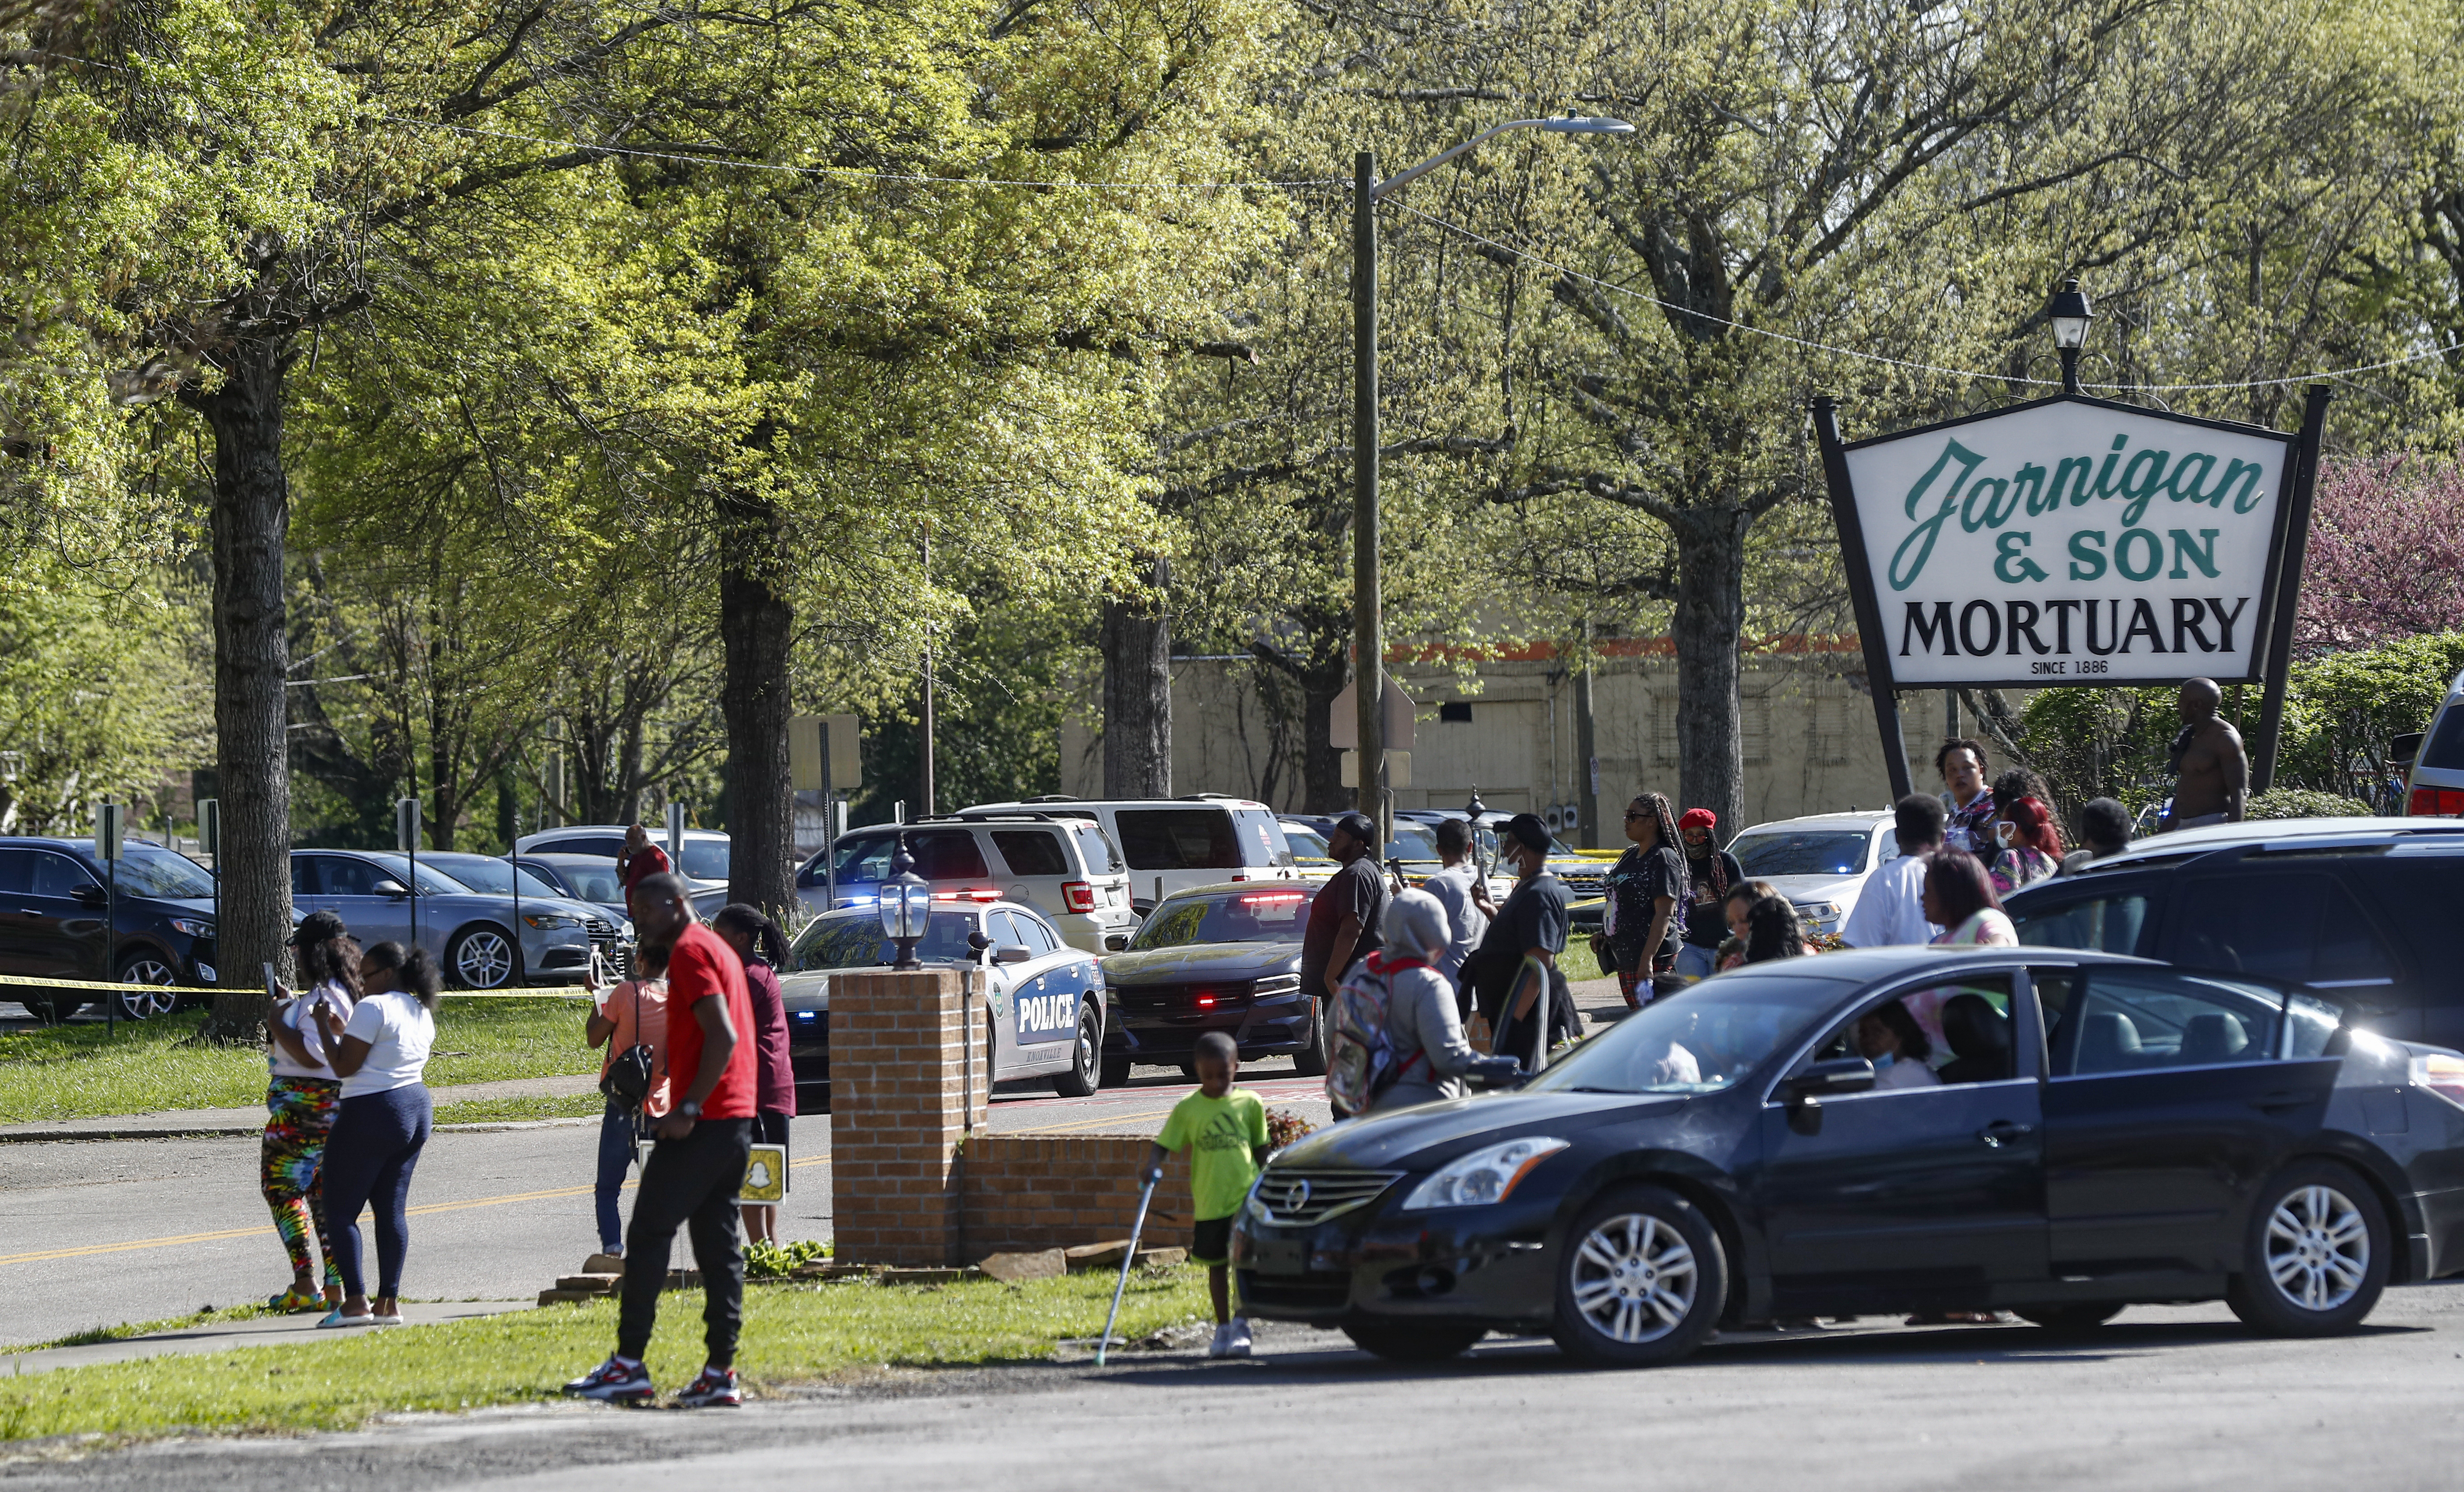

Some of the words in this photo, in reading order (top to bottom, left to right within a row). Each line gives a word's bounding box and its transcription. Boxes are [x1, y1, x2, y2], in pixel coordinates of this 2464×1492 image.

[1889, 433, 2264, 591] Jarnigan
[1994, 531, 2050, 583] &
[2068, 528, 2221, 582] SON
[1899, 597, 2251, 656] MORTUARY
[2032, 662, 2066, 674] SINCE
[2075, 660, 2108, 673] 1886
[1019, 993, 1074, 1033] POLICE
[1027, 1048, 1061, 1062] KNOXVILLE
